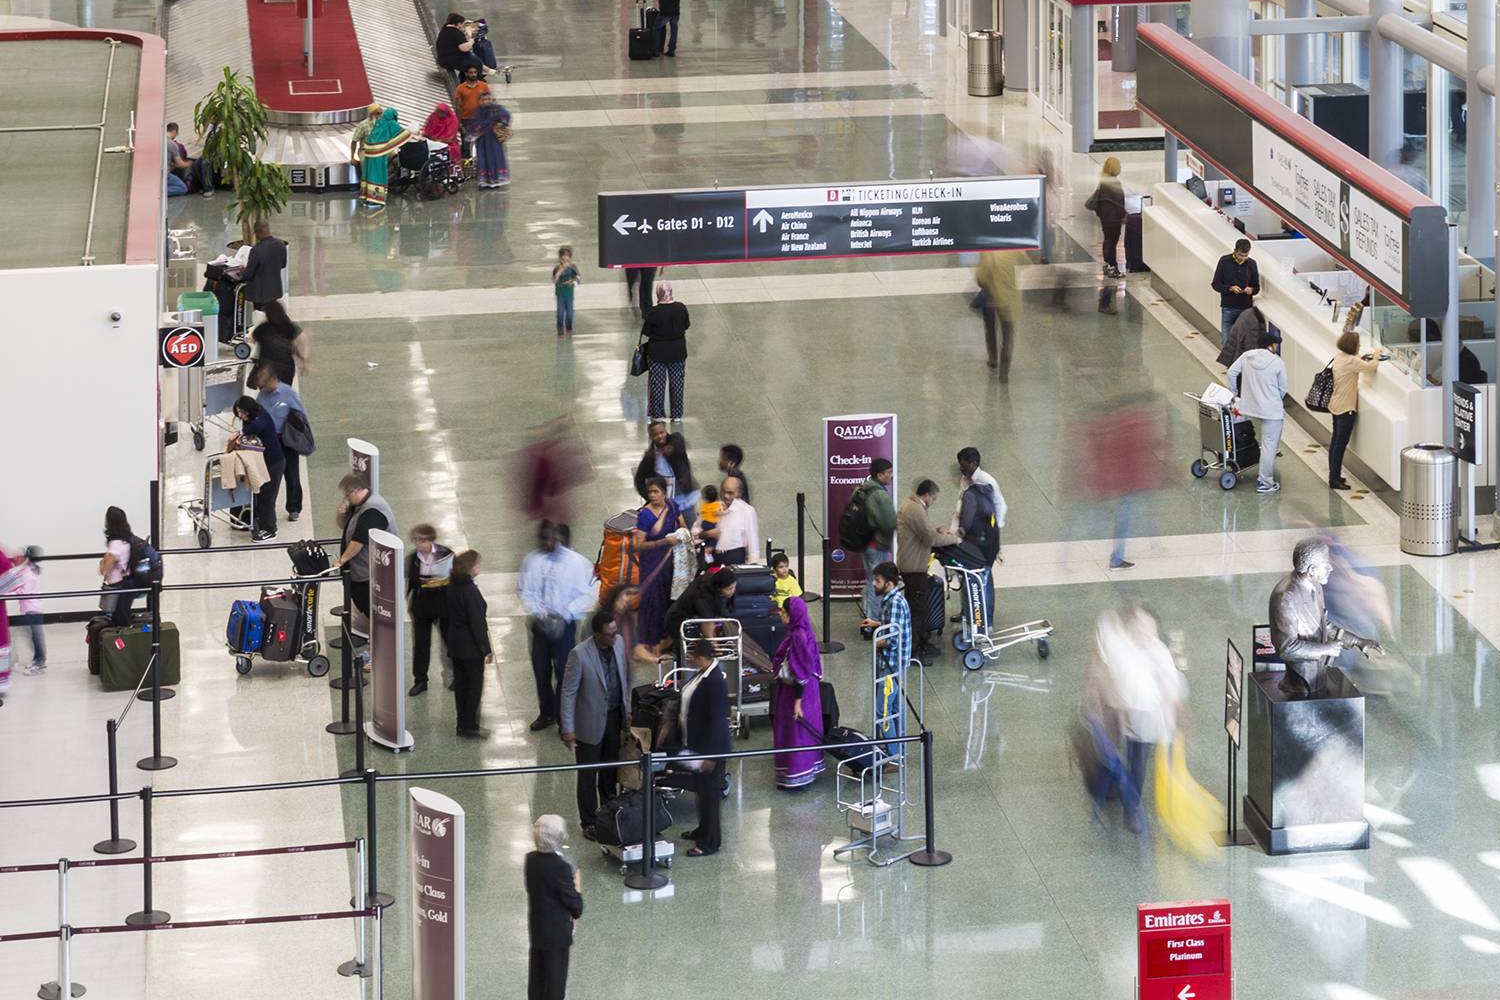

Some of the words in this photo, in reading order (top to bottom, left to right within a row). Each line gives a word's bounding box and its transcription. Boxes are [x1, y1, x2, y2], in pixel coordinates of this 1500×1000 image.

[830, 191, 836, 200] D
[858, 187, 962, 201] TICKETING/CHECK-IN
[1313, 179, 1327, 202] SALES
[1327, 187, 1336, 210] TAX
[850, 208, 858, 216] All
[860, 208, 879, 217] Nippon
[880, 207, 902, 216] Airways
[912, 207, 923, 215] KLM
[990, 203, 1028, 212] VivaAerobus
[781, 210, 813, 219] AeroMexico
[990, 214, 1012, 223] Volaris
[1314, 201, 1336, 230] REFUNDS
[1340, 197, 1349, 238] $
[657, 218, 687, 231] Gates
[691, 217, 703, 229] D1
[716, 216, 734, 228] D12
[781, 222, 790, 230] Air
[791, 221, 807, 230] China
[850, 219, 872, 227] Avianca
[912, 217, 931, 226] Korean
[932, 216, 941, 225] Air
[1353, 207, 1369, 232] SALES
[1370, 217, 1379, 240] TAX
[781, 232, 790, 241] Air
[791, 232, 809, 240] France
[850, 230, 869, 238] British
[870, 229, 892, 239] Airways
[912, 228, 939, 236] Lufthansa
[781, 243, 790, 252] Air
[791, 243, 803, 251] New
[804, 242, 827, 251] Zealand
[850, 240, 872, 249] InterJet
[912, 238, 931, 247] Turkish
[932, 237, 954, 246] Airlines
[1355, 230, 1378, 260] REFUNDS
[171, 343, 198, 354] AED
[1454, 405, 1474, 422] RELATIVE
[1455, 416, 1471, 432] CENTER
[834, 425, 873, 438] QATAR
[830, 455, 872, 465] Check-in
[830, 476, 866, 485] Economy
[971, 582, 982, 627] smartecarte
[306, 589, 315, 634] smartecarte
[377, 605, 392, 618] Class
[424, 885, 446, 899] Class
[427, 909, 448, 923] Gold
[1145, 913, 1204, 928] Emirates
[1167, 940, 1185, 948] First
[1185, 939, 1205, 947] Class
[1170, 953, 1203, 961] Platinum
